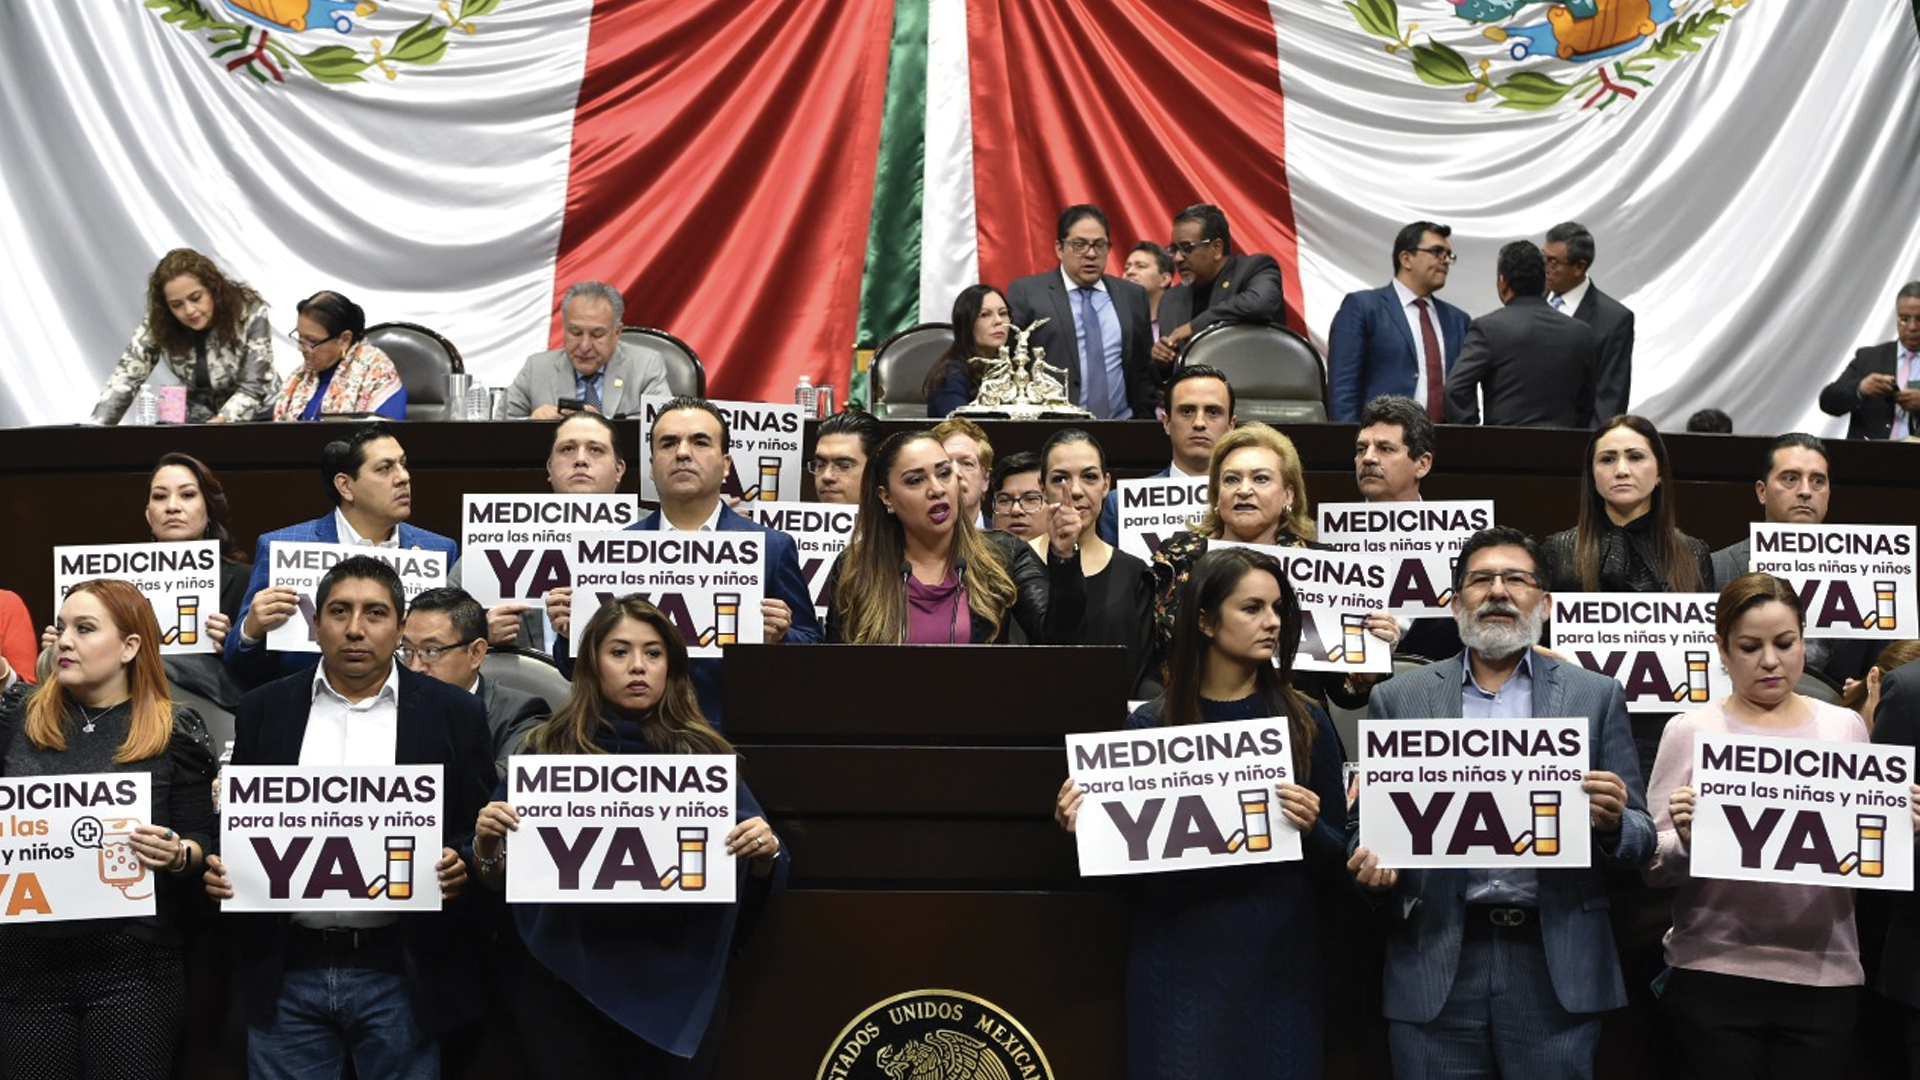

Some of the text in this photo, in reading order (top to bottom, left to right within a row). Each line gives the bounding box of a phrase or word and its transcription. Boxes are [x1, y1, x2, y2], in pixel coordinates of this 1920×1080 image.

[746, 440, 755, 452] y
[759, 438, 798, 451] niños
[469, 502, 632, 524] MEDICINAS
[1124, 515, 1159, 529] para
[1162, 512, 1184, 525] las
[1324, 508, 1488, 533] MEDICINAS
[468, 532, 504, 545] para
[507, 530, 529, 543] las
[798, 538, 819, 551] las
[1364, 539, 1386, 552] las
[1390, 538, 1432, 551] niñas
[1435, 541, 1445, 553] y
[1756, 531, 1911, 556] MEDICINAS
[61, 549, 214, 575] MEDICINAS
[577, 540, 759, 565] MEDICINAS
[484, 549, 571, 599] YA
[577, 571, 759, 588] para las niñas y niños
[1756, 560, 1912, 576] para las niñas y niños
[164, 581, 173, 593] y
[176, 576, 215, 590] niños
[276, 576, 313, 587] para
[1328, 594, 1338, 608] y
[1341, 593, 1384, 610] niños
[1556, 601, 1716, 624] MEDICINAS
[1556, 630, 1715, 646] para las niñas y niño
[1075, 728, 1283, 770] MEDICINAS
[1367, 728, 1581, 758] MEDICINAS
[1367, 765, 1582, 785] para las niñas y niños
[1702, 743, 1908, 784] MEDICINAS
[229, 775, 436, 804] MEDICINAS
[516, 765, 728, 793] MEDICINAS
[1078, 764, 1287, 794] para las niñas y niños
[1700, 781, 1908, 808] para las niñas y niños
[228, 811, 436, 831] para las niñas y niños
[515, 801, 729, 821] para las niñas y niños
[1388, 791, 1514, 855] YA
[10, 815, 49, 837] las
[1101, 795, 1228, 861] YA
[1721, 803, 1840, 874] YA
[1, 843, 75, 866] y niños
[536, 827, 661, 890] YA
[249, 836, 368, 899] YA
[888, 1001, 964, 1026] UNIDOS
[974, 1013, 1042, 1080] MEXICA
